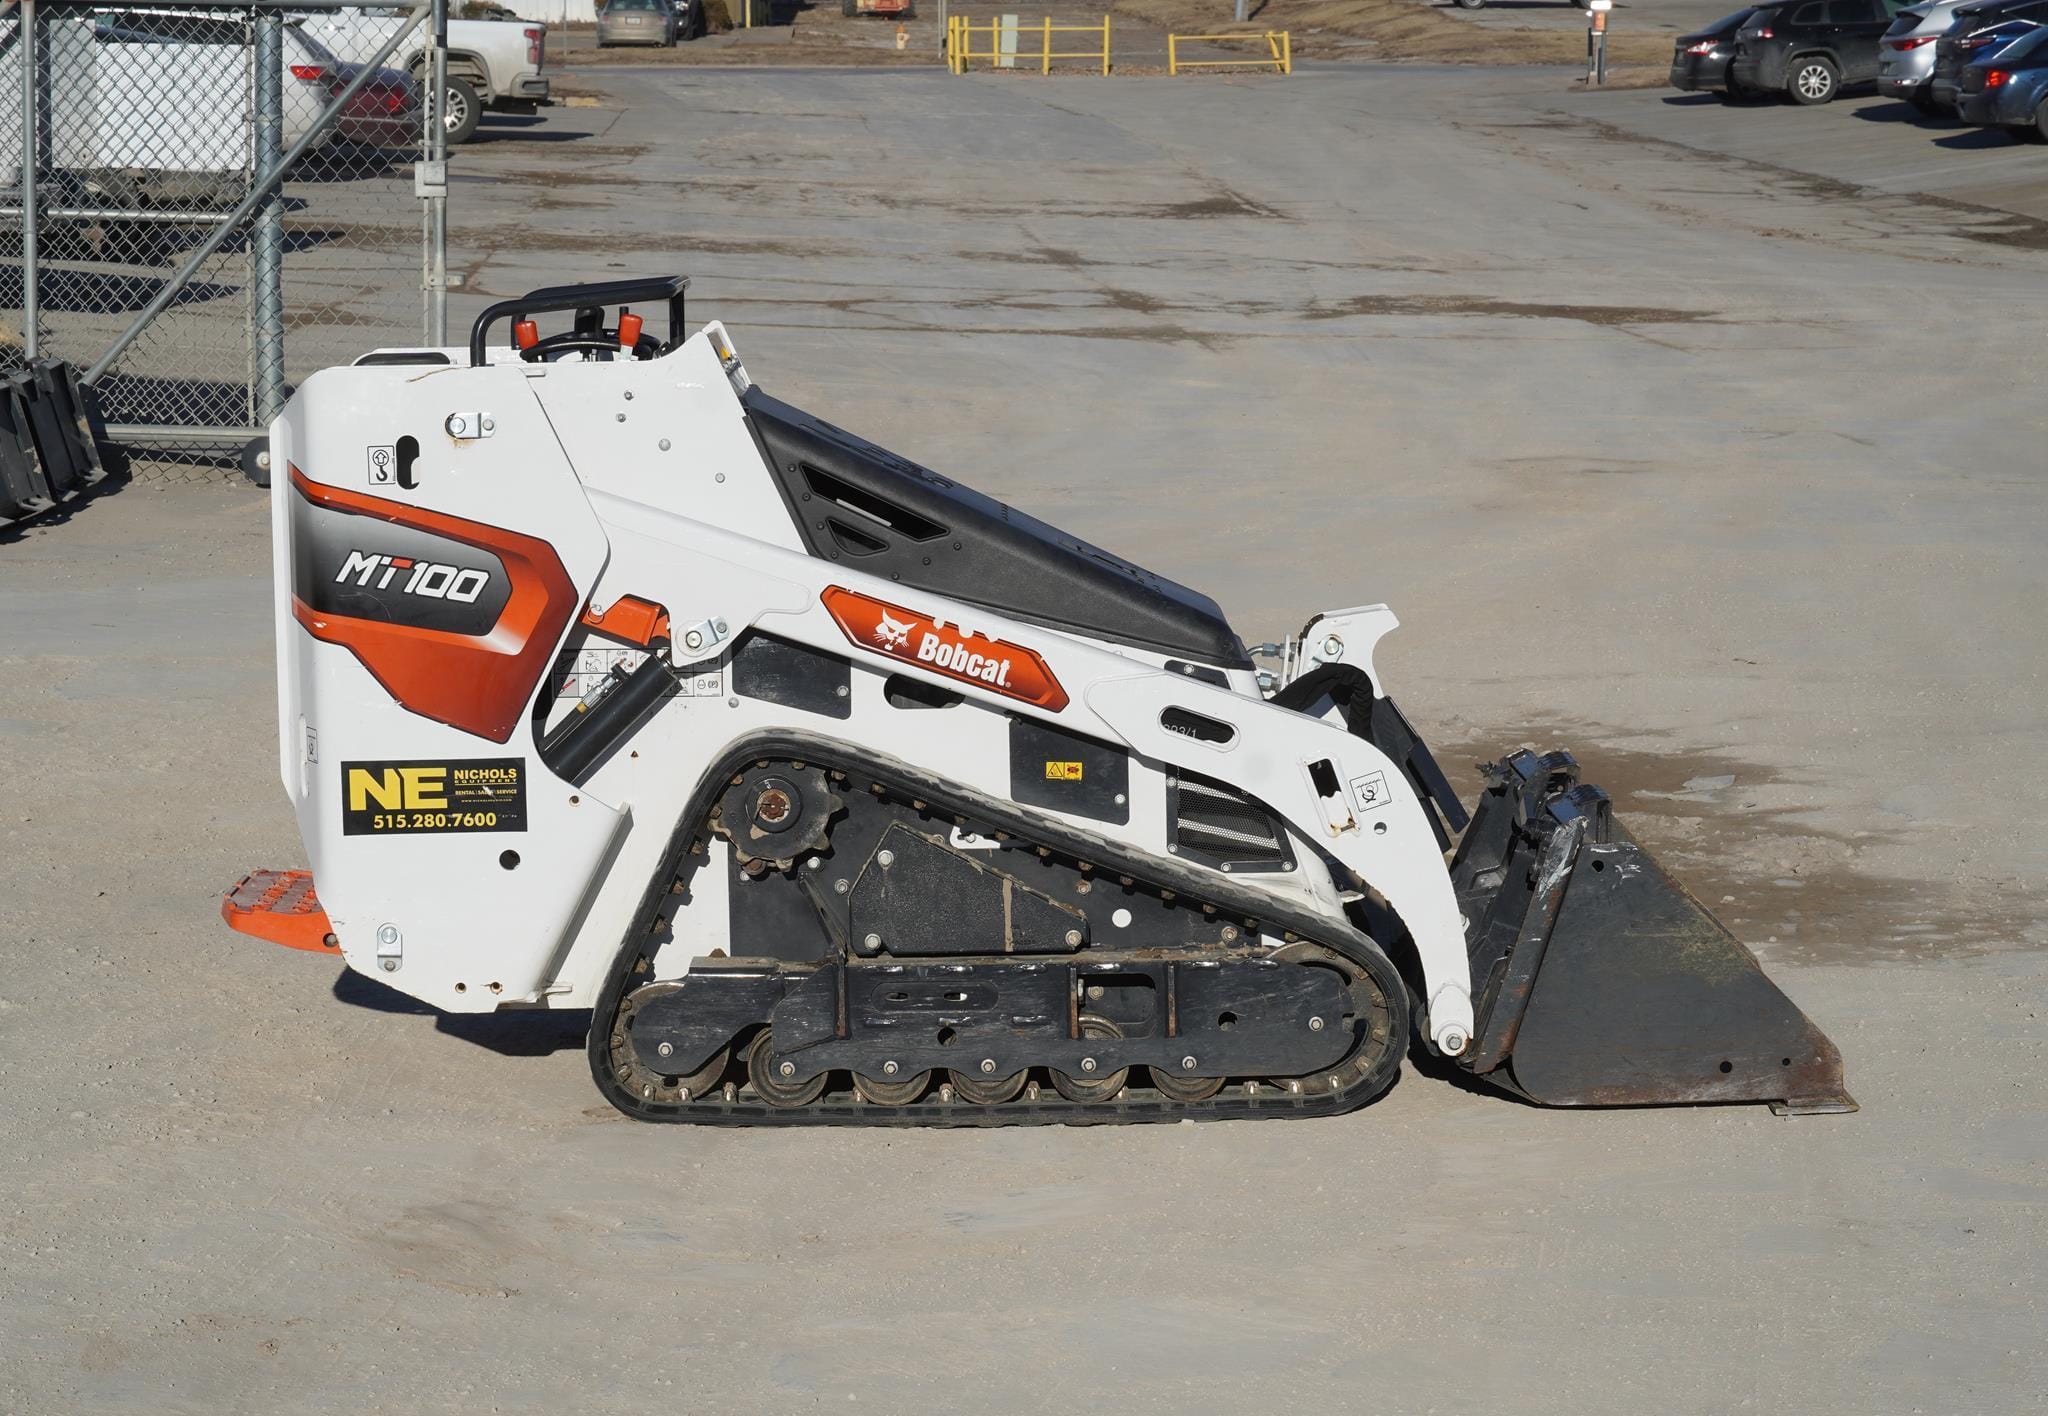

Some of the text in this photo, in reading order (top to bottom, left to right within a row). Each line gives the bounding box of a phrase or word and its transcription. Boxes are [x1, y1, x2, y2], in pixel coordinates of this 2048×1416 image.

[334, 550, 491, 604] MT100
[917, 632, 1011, 687] Bobcat
[349, 767, 448, 811] NE
[454, 768, 517, 780] NICHOLS
[373, 812, 497, 829] 515.280.7600
